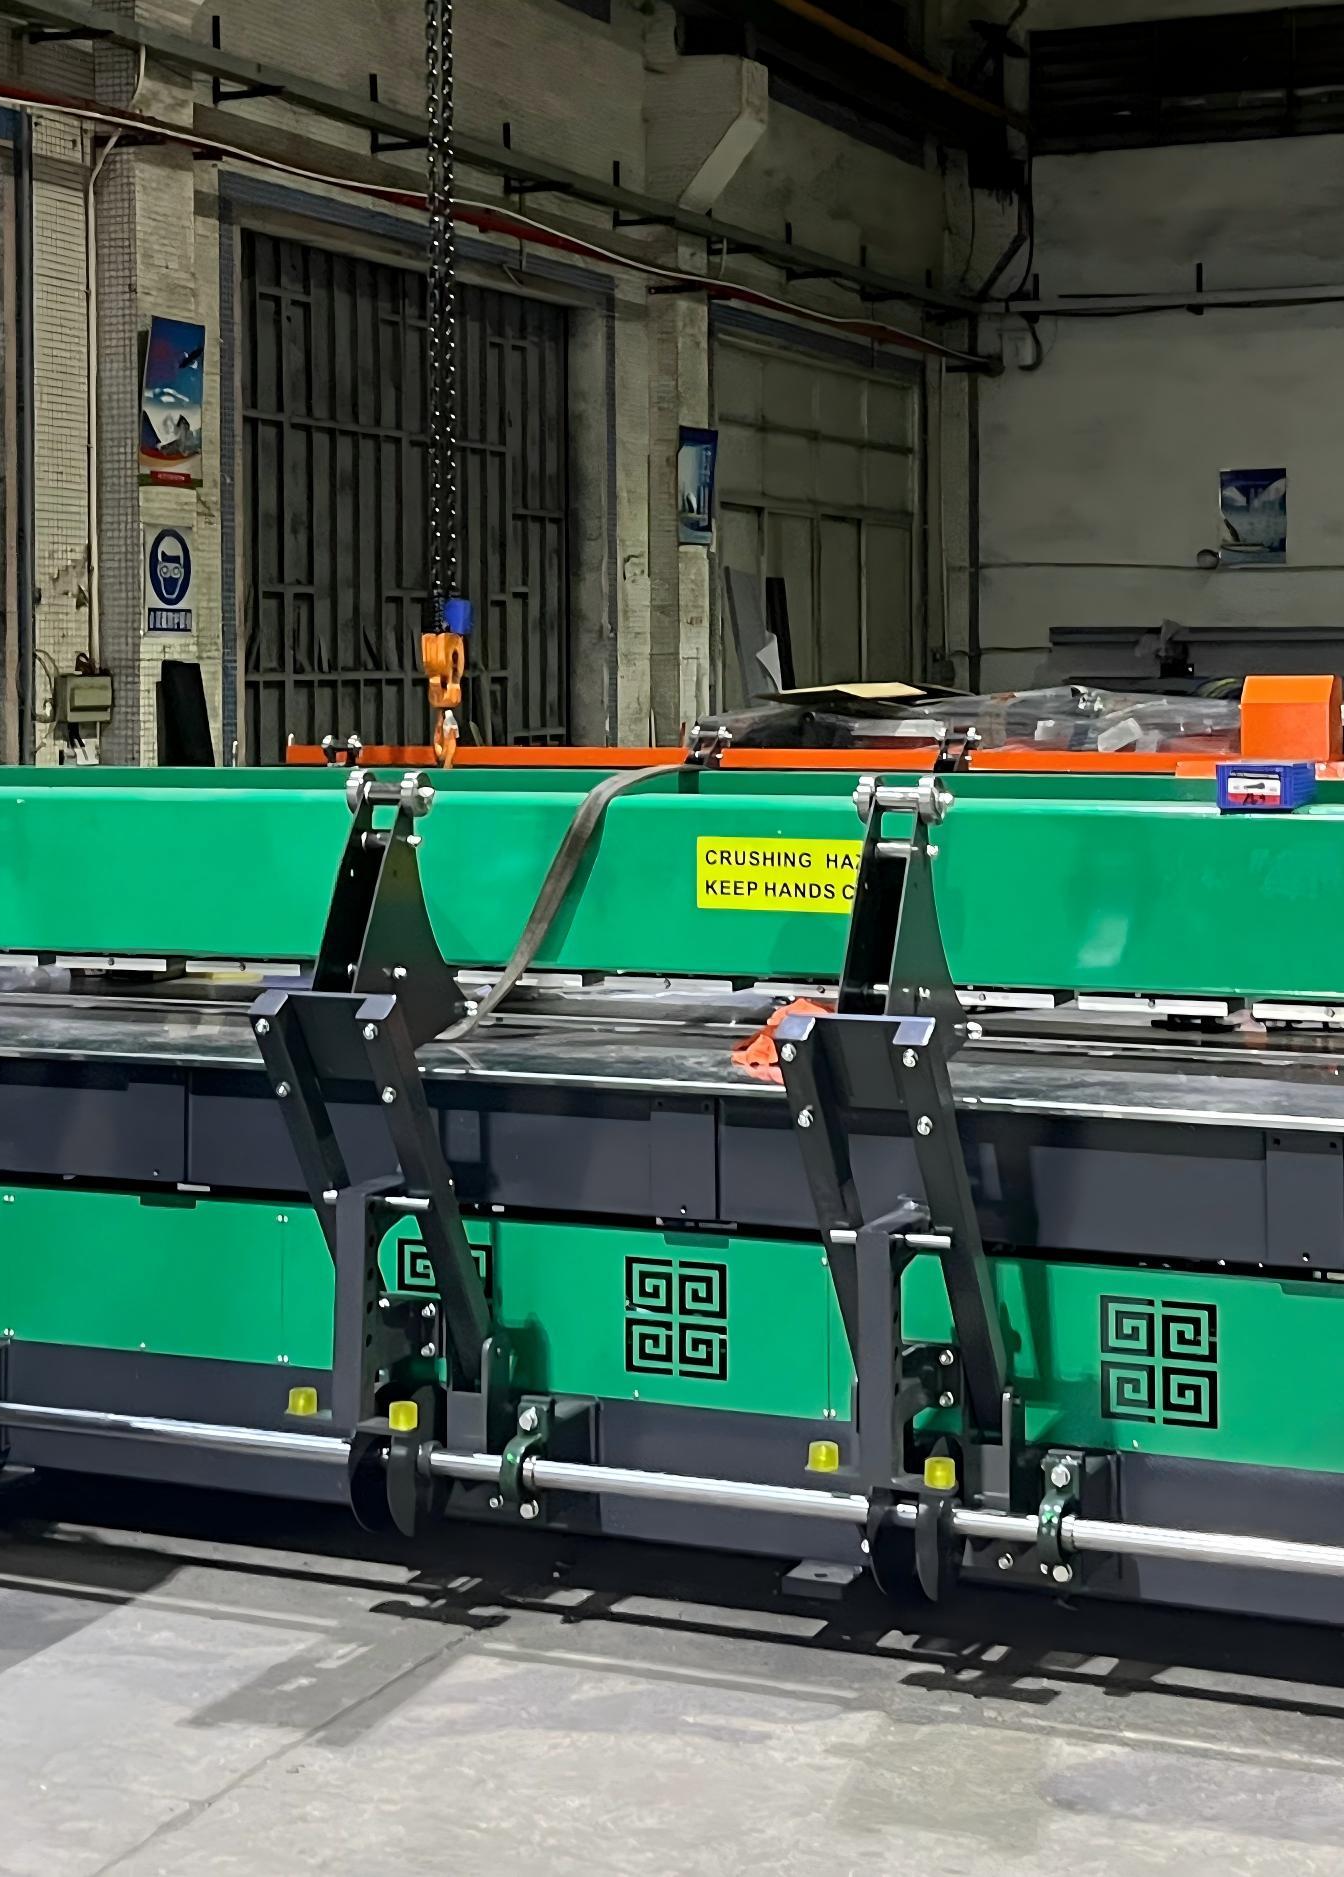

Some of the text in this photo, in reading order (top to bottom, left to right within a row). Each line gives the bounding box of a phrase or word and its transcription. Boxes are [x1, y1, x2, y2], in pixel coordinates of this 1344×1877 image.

[705, 849, 863, 870] CRUSHING HA
[705, 880, 758, 897] KEEP
[764, 882, 835, 900] HANDS
